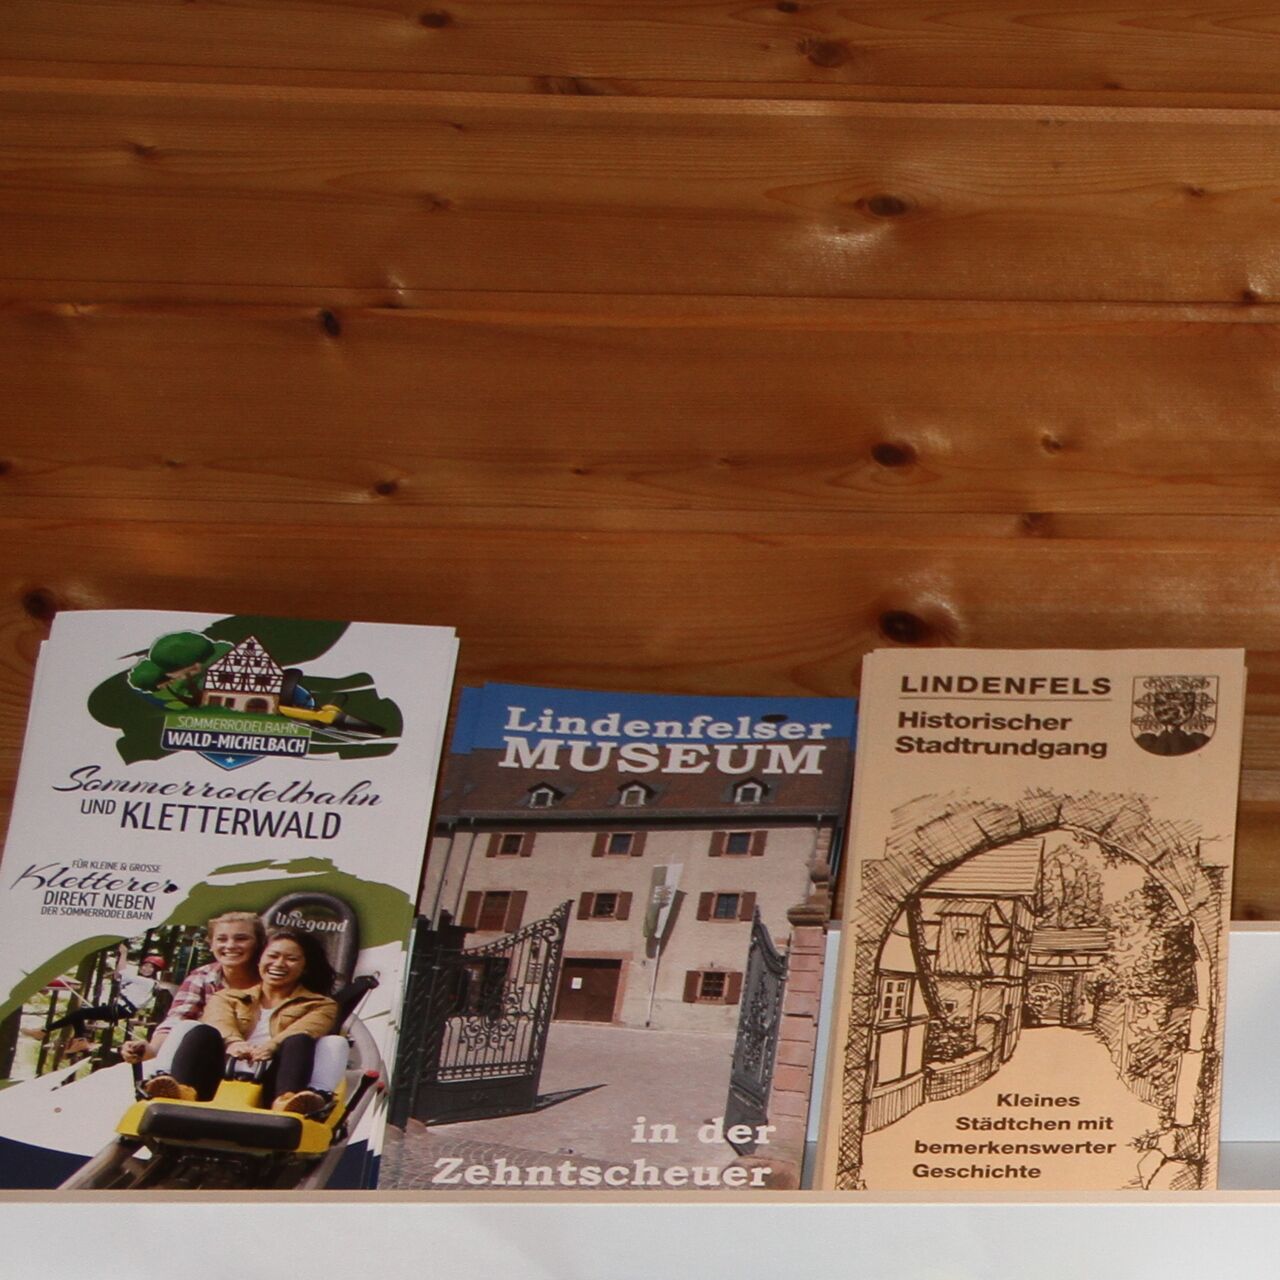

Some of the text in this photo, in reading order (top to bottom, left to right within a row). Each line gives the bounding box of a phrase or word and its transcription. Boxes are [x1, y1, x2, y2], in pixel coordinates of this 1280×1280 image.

[901, 676, 1111, 695] LINDENFELS
[177, 716, 299, 735] SOMMERRODELBAHN
[504, 706, 831, 740] Lindenfelser
[898, 711, 1072, 732] Historischer
[167, 733, 306, 753] WALD-MICHELBACH
[895, 736, 1108, 759] Stadtrundgang
[498, 736, 826, 775] MUSEUM
[52, 765, 383, 808] Sommerrodelbahn
[81, 800, 341, 840] UND KLETTERWALD
[72, 858, 161, 873] FÜR KLEINE & GROSSE
[43, 890, 156, 911] DIREKT NEBEN
[40, 906, 154, 920] DER SOMMERRODELBAHN
[275, 910, 348, 933] Wiegand
[997, 1093, 1081, 1108] Kleines
[631, 1116, 777, 1145] in der
[955, 1116, 1114, 1132] Städtchen mit
[914, 1140, 1117, 1155] bemerkenswerter
[432, 1157, 772, 1187] Zehntscheuer
[912, 1164, 1041, 1179] Geschichte
